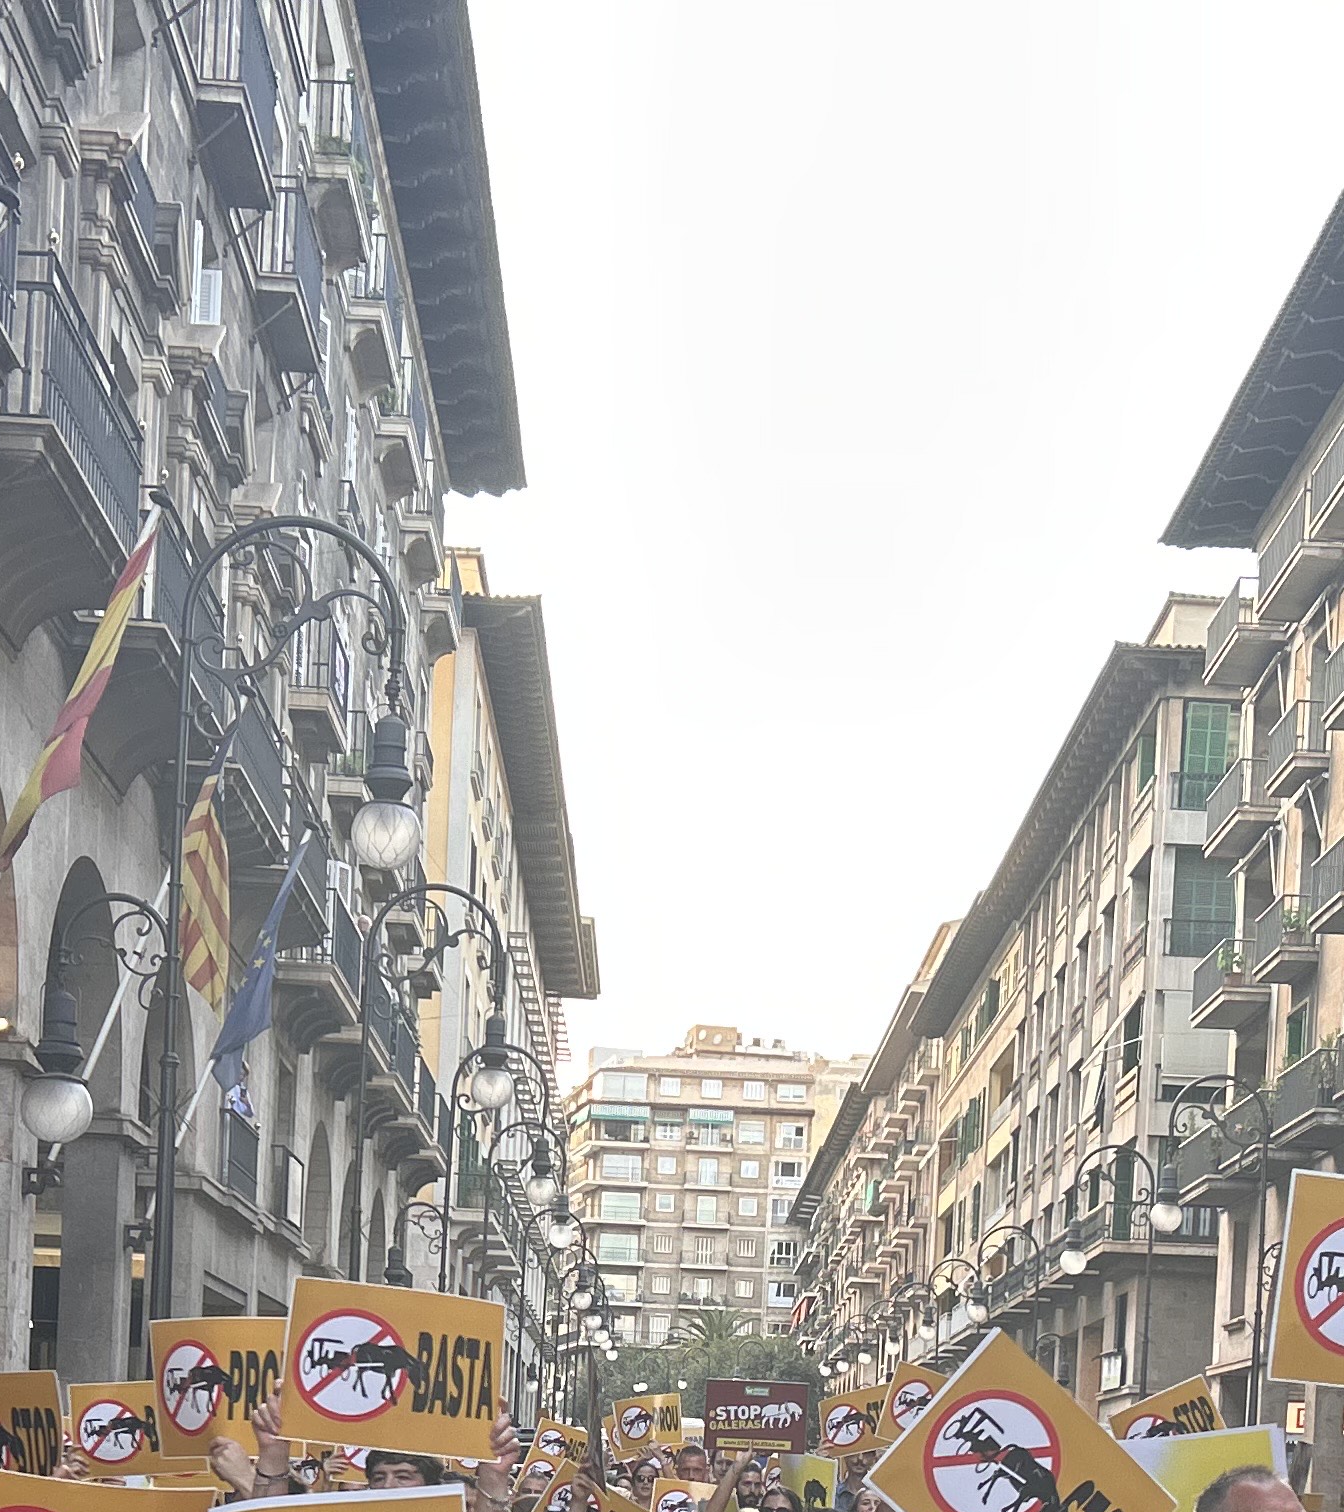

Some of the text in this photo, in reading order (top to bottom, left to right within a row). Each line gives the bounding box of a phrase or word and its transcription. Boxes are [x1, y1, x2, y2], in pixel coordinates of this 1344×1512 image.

[412, 1331, 494, 1422] BASTA
[11, 1406, 58, 1477] STOP
[709, 1419, 762, 1431] GALERAS
[1172, 1395, 1216, 1434] STOP
